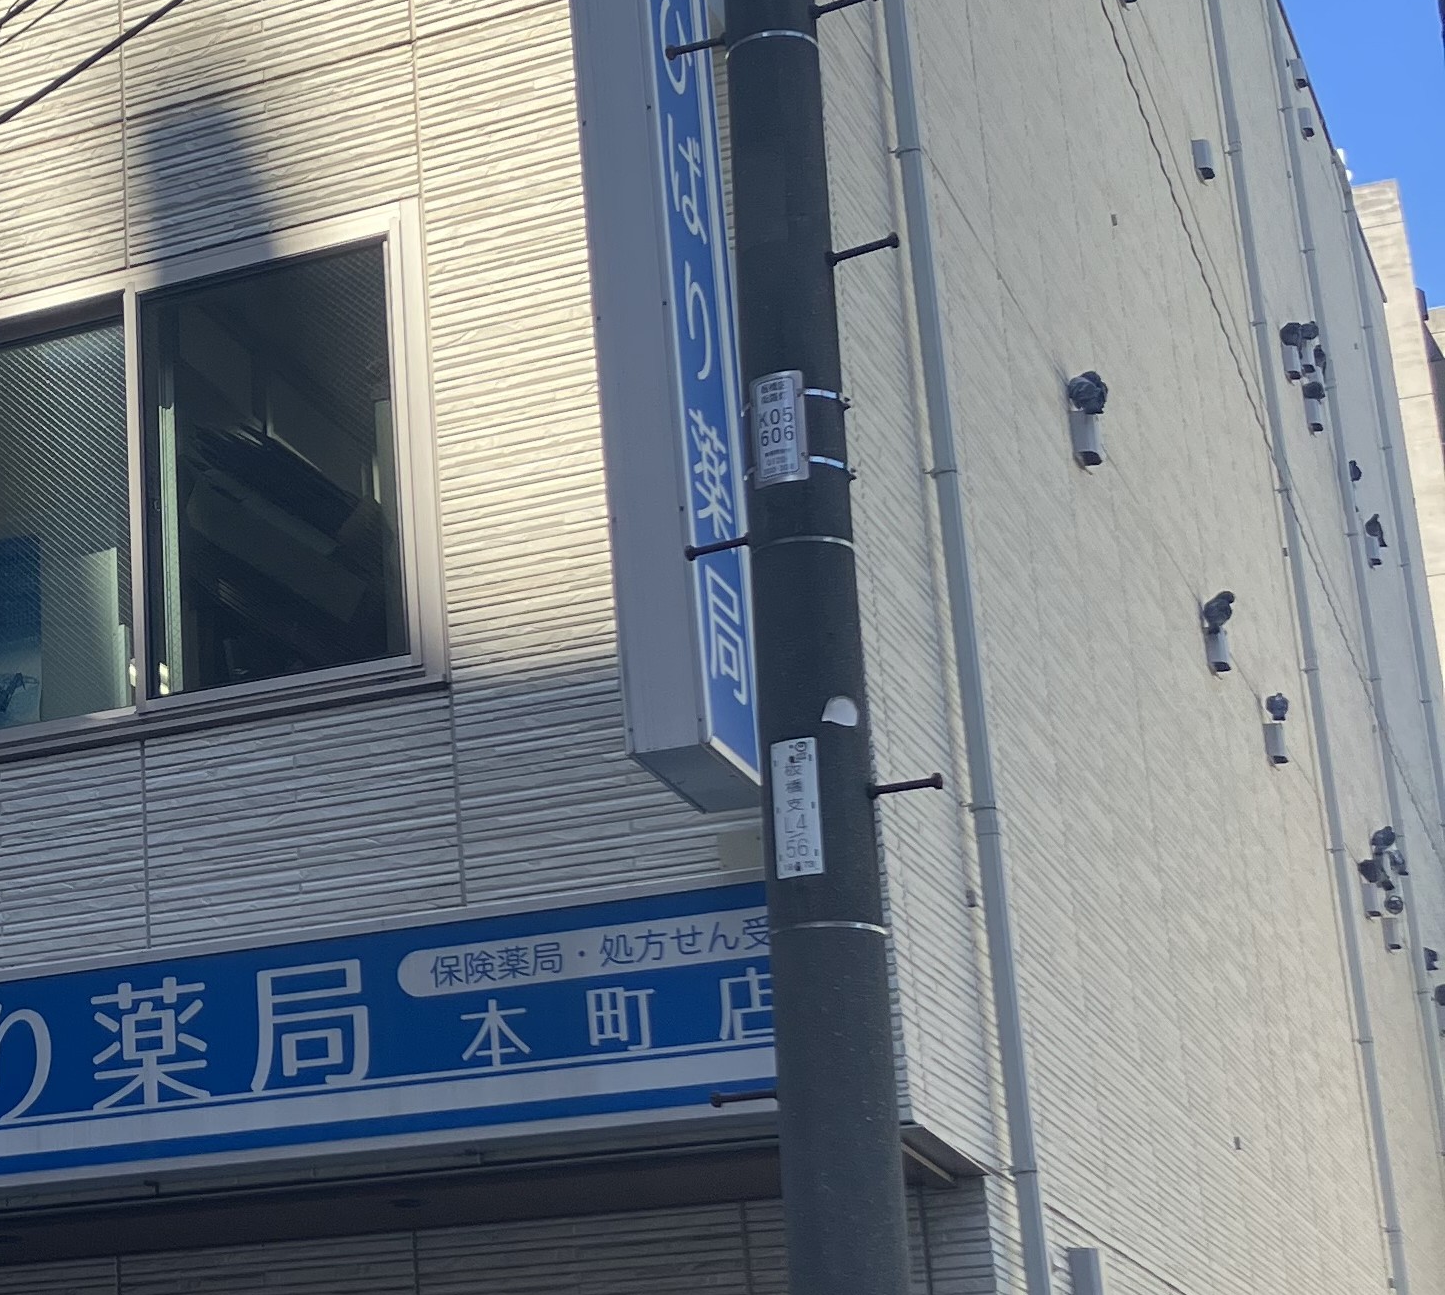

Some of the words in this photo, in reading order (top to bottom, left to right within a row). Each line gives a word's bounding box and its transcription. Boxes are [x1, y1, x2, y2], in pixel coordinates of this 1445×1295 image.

[759, 407, 793, 428] K05
[760, 425, 794, 447] 606
[786, 839, 809, 858] 56
[430, 916, 769, 988] 保険薬局・処方せん受
[461, 967, 775, 1067] 本町店
